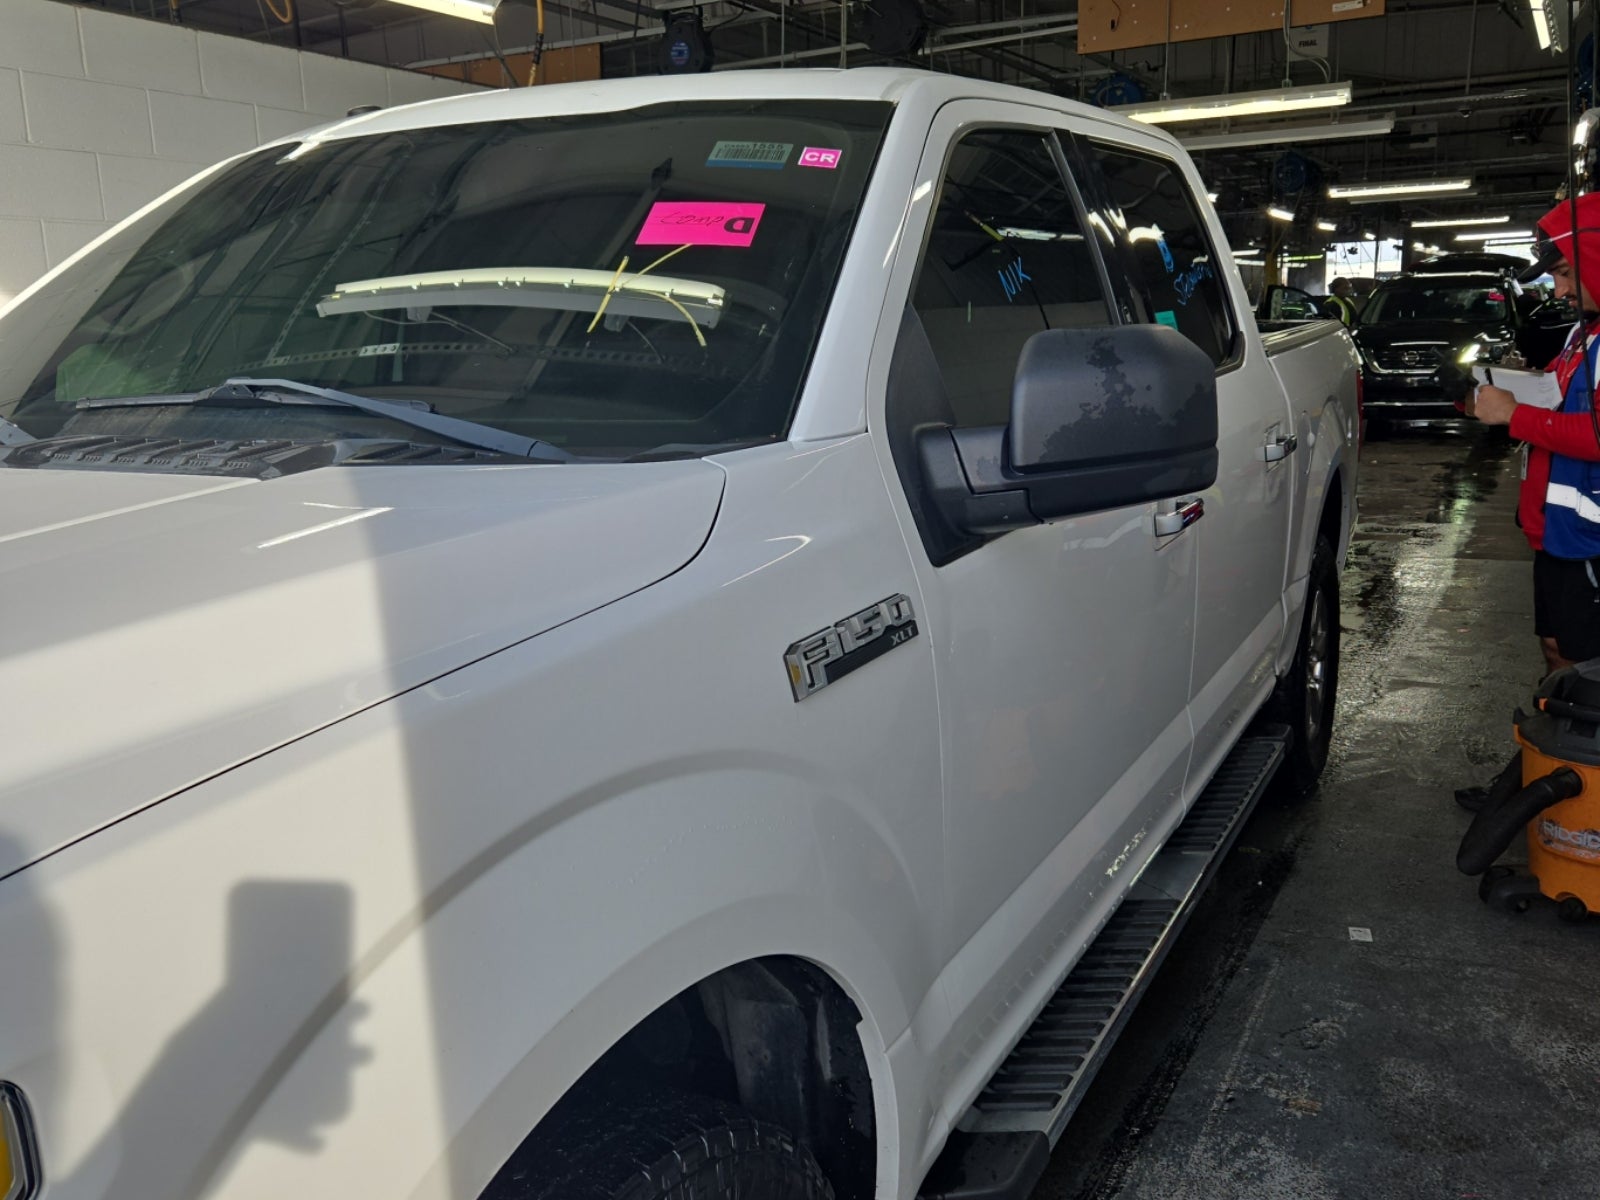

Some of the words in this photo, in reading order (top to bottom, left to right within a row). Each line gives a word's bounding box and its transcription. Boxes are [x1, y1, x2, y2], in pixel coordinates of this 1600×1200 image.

[1297, 39, 1318, 48] FINAL
[804, 151, 835, 163] CR
[891, 624, 914, 647] XLT
